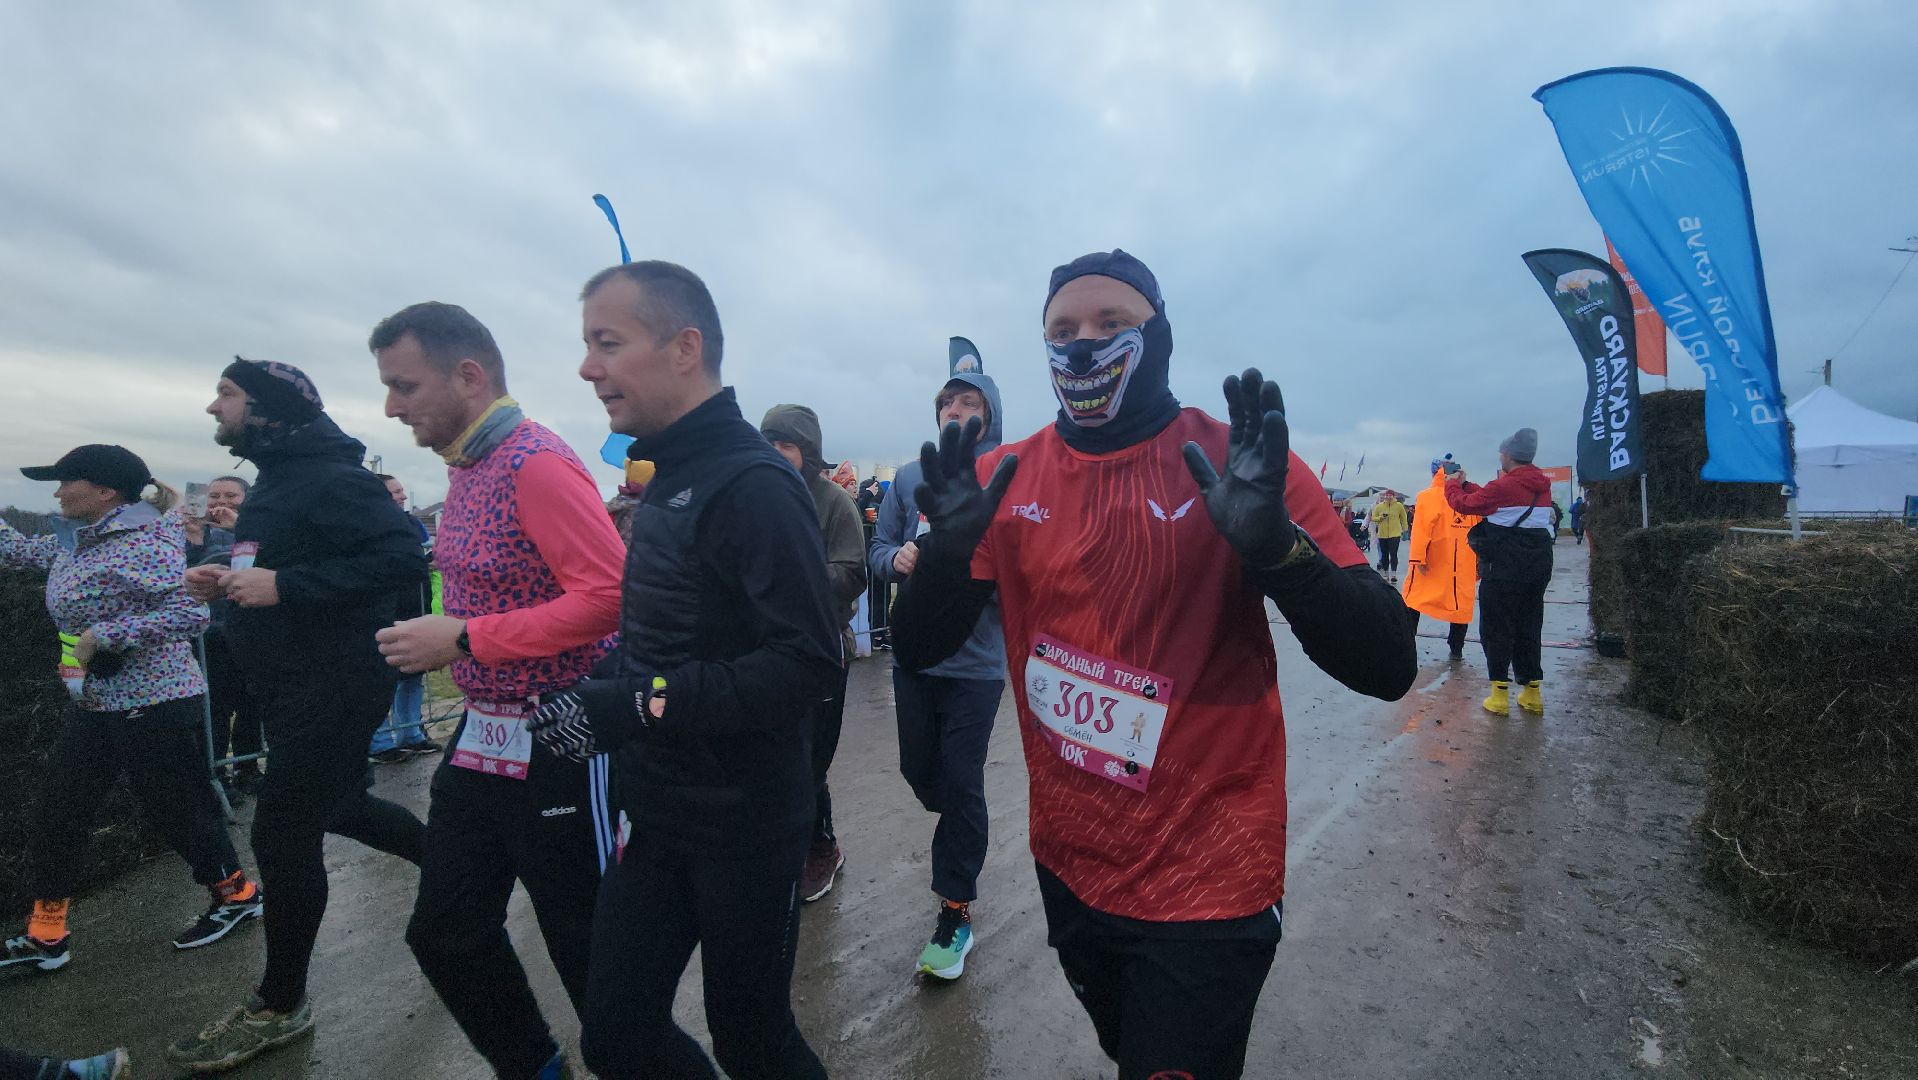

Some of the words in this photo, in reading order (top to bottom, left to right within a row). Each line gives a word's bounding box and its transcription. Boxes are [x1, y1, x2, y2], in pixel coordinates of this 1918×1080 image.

[1011, 501, 1051, 524] TRAIL
[1053, 681, 1119, 733] 303
[478, 720, 507, 747] 280
[541, 806, 577, 817] adidas
